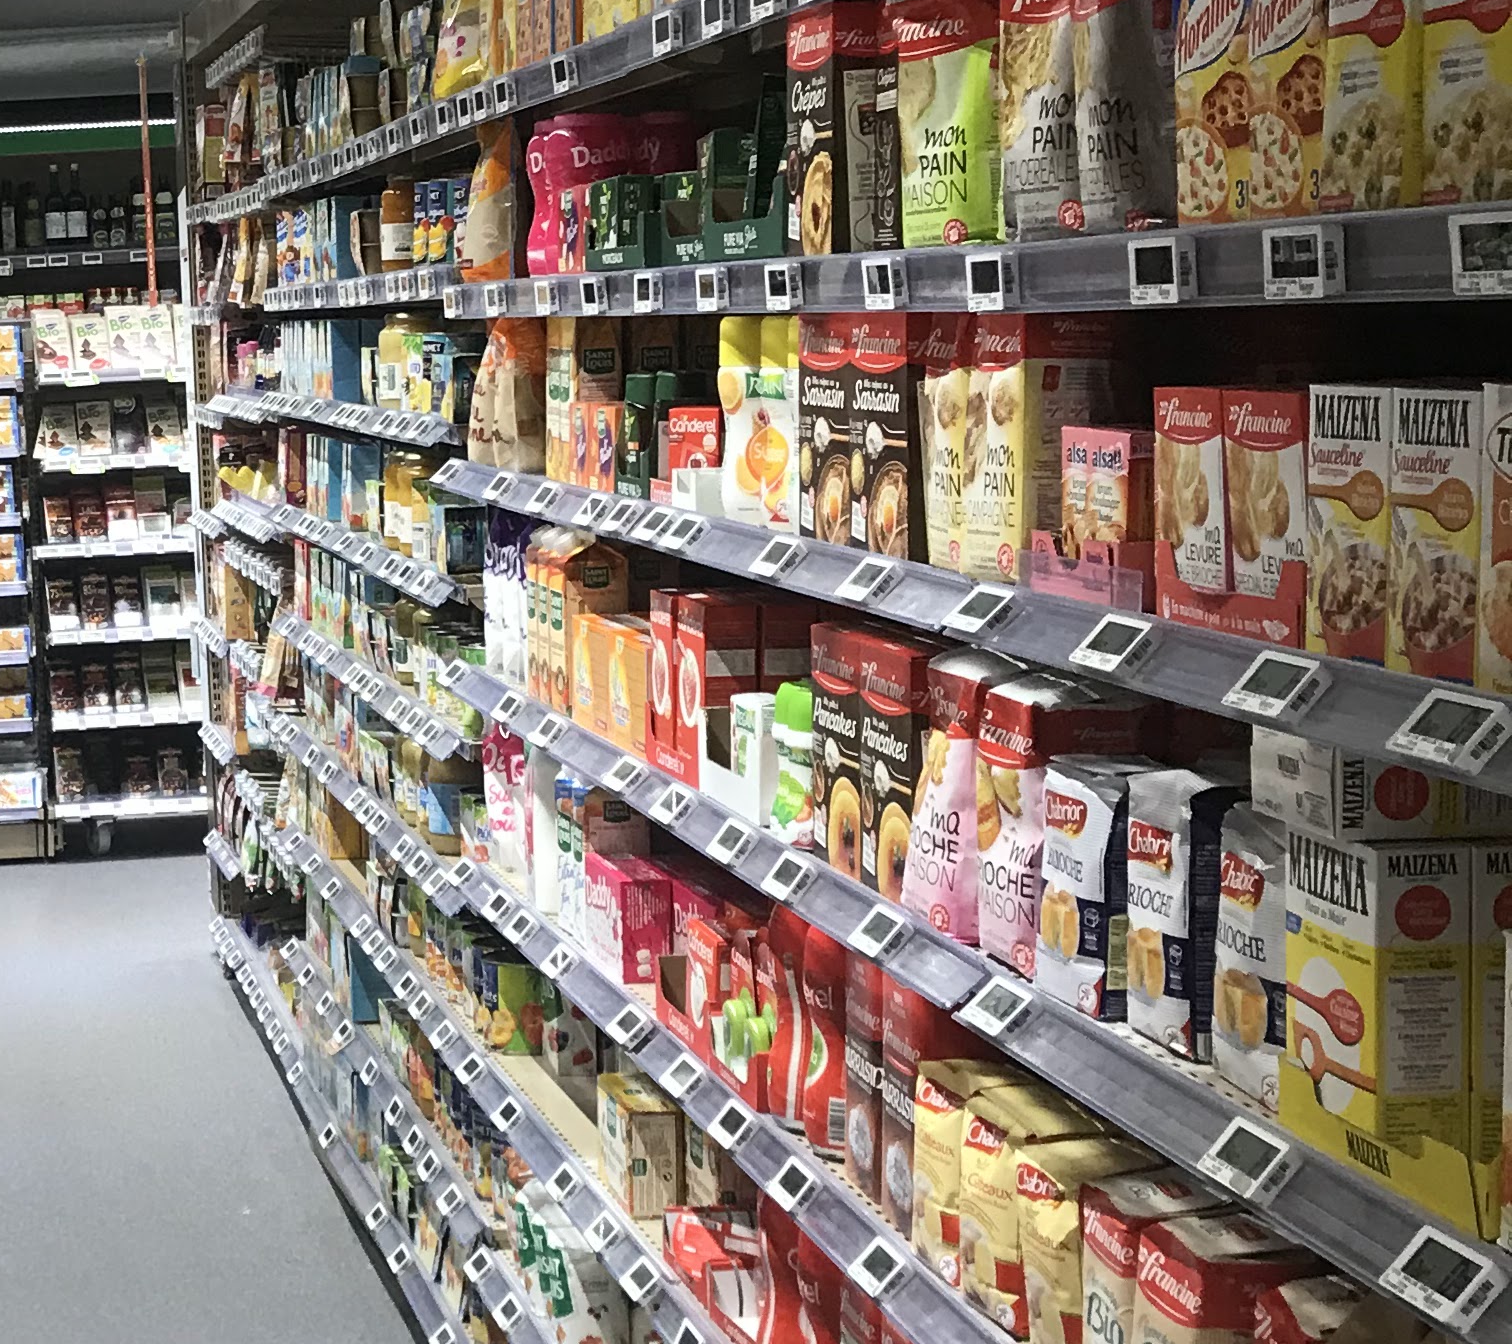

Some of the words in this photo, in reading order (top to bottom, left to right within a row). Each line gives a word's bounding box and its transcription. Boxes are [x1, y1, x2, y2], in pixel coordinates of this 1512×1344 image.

[792, 81, 828, 116] Crêpes
[924, 126, 967, 148] mon
[919, 152, 967, 177] PAIN
[38, 326, 60, 339] Bio
[77, 326, 99, 338] Bio
[110, 319, 133, 332] Bio
[141, 317, 165, 331] Bio
[856, 323, 901, 357] francine
[803, 378, 845, 410] Sarrasin
[853, 378, 900, 413] Sarrasin
[669, 414, 717, 434] Canderel
[1163, 397, 1213, 430] francine
[1234, 402, 1291, 436] francine
[1315, 394, 1381, 441] MAIZENA
[1399, 398, 1471, 448] MAIZENA
[935, 473, 961, 497] PAIN
[984, 472, 1015, 497] PAIN
[867, 662, 906, 703] francine
[813, 697, 857, 740] Pancakes
[862, 718, 908, 762] Pancakes
[1288, 831, 1370, 916] MAIZENA
[1388, 852, 1458, 878] MAIZENA
[983, 890, 1035, 930] AISON
[1128, 882, 1175, 920] RIOCHE
[1216, 924, 1267, 963] RIOCHE
[1139, 1244, 1203, 1316] francine
